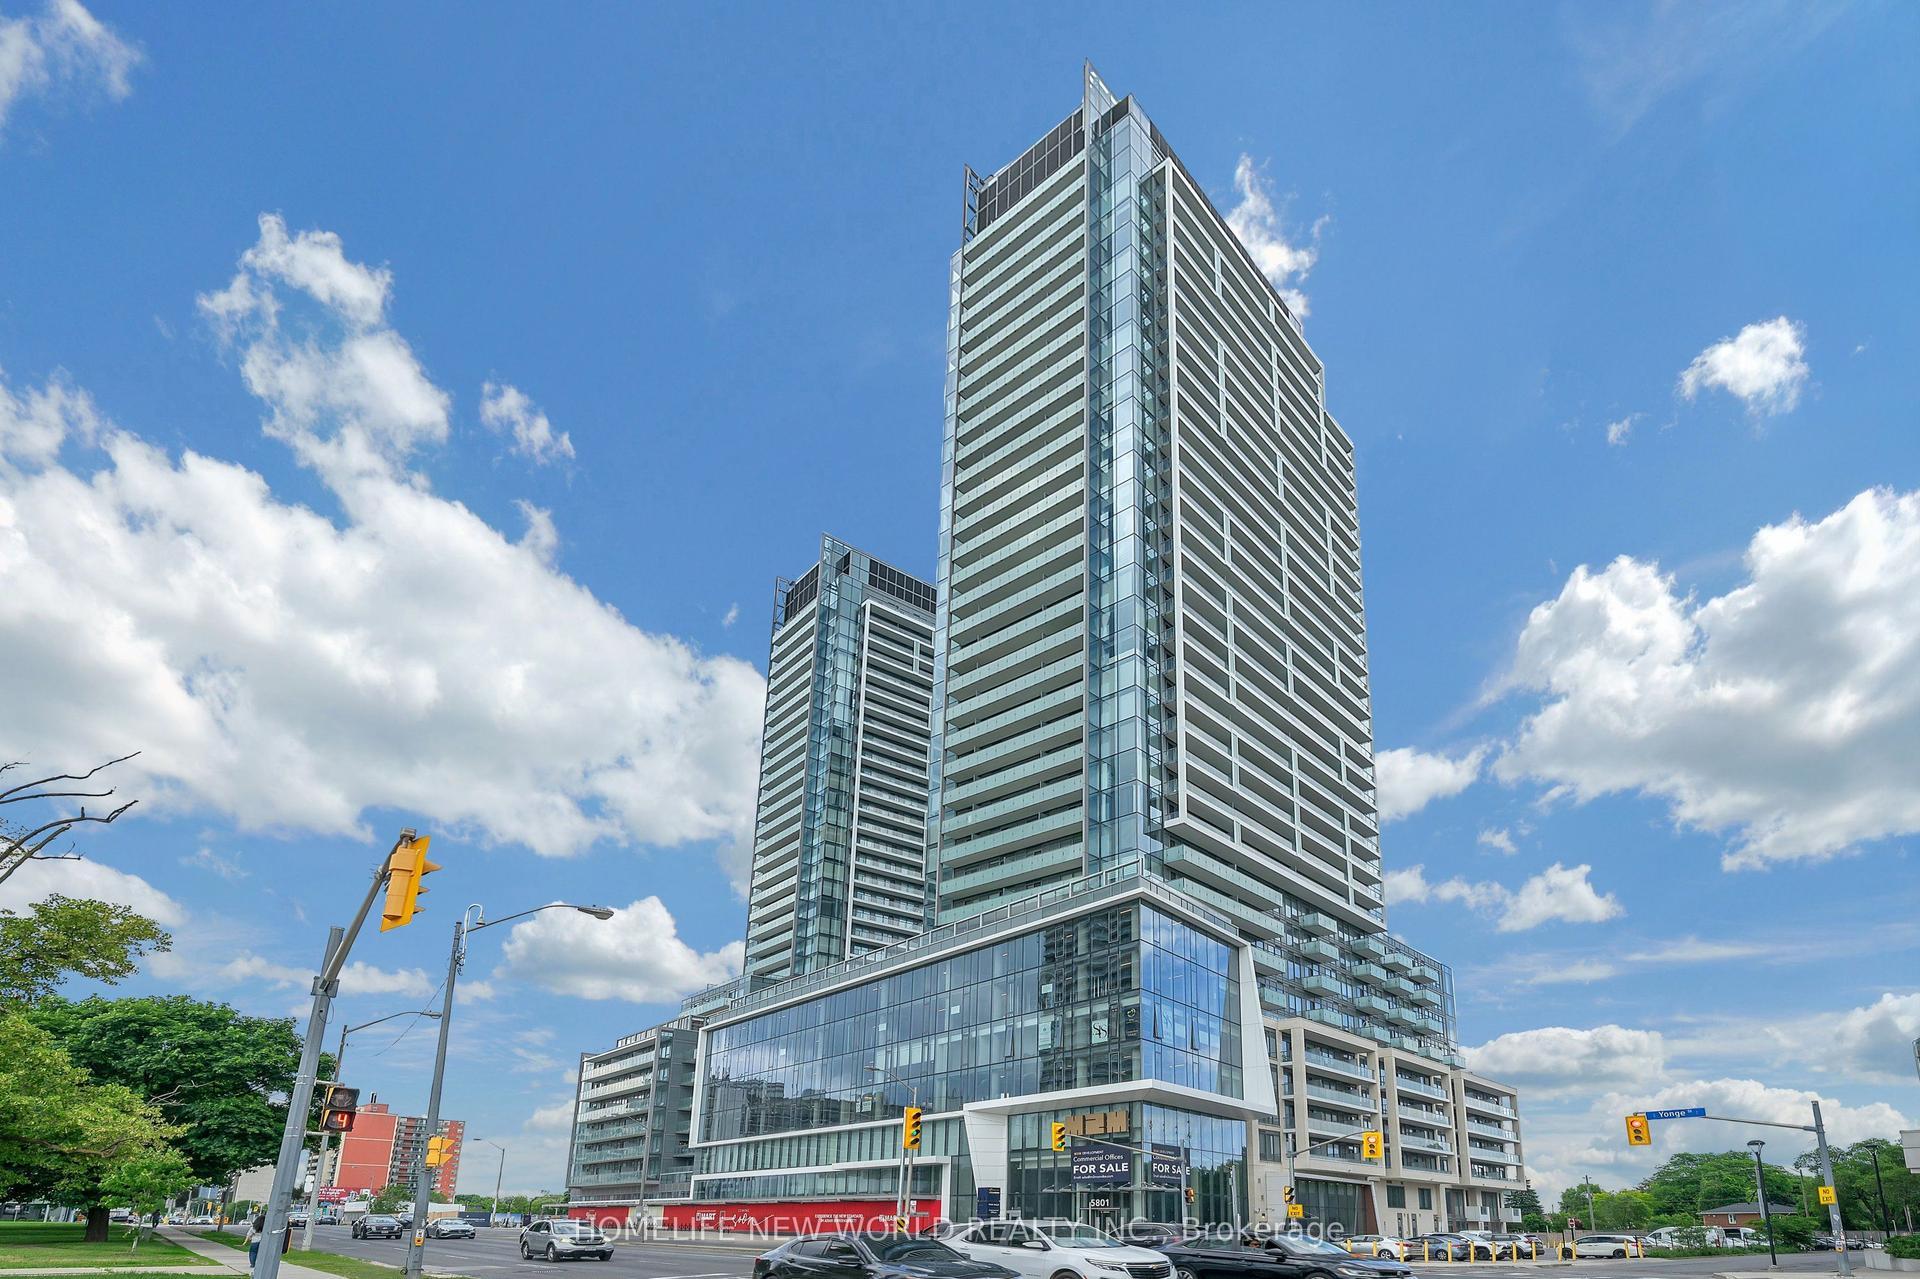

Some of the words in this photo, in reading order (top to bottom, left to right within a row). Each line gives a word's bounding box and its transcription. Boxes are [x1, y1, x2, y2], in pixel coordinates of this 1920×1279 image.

[1659, 1110, 1686, 1118] Yonge
[337, 1113, 348, 1128] 4
[1073, 1155, 1104, 1163] Commercial
[1104, 1153, 1124, 1161] Offices
[1073, 1164, 1096, 1174] FOR
[1099, 1162, 1129, 1173] SALE
[1152, 1162, 1170, 1174] FOR
[1171, 1164, 1191, 1176] SAE
[1090, 1199, 1110, 1207] 5801
